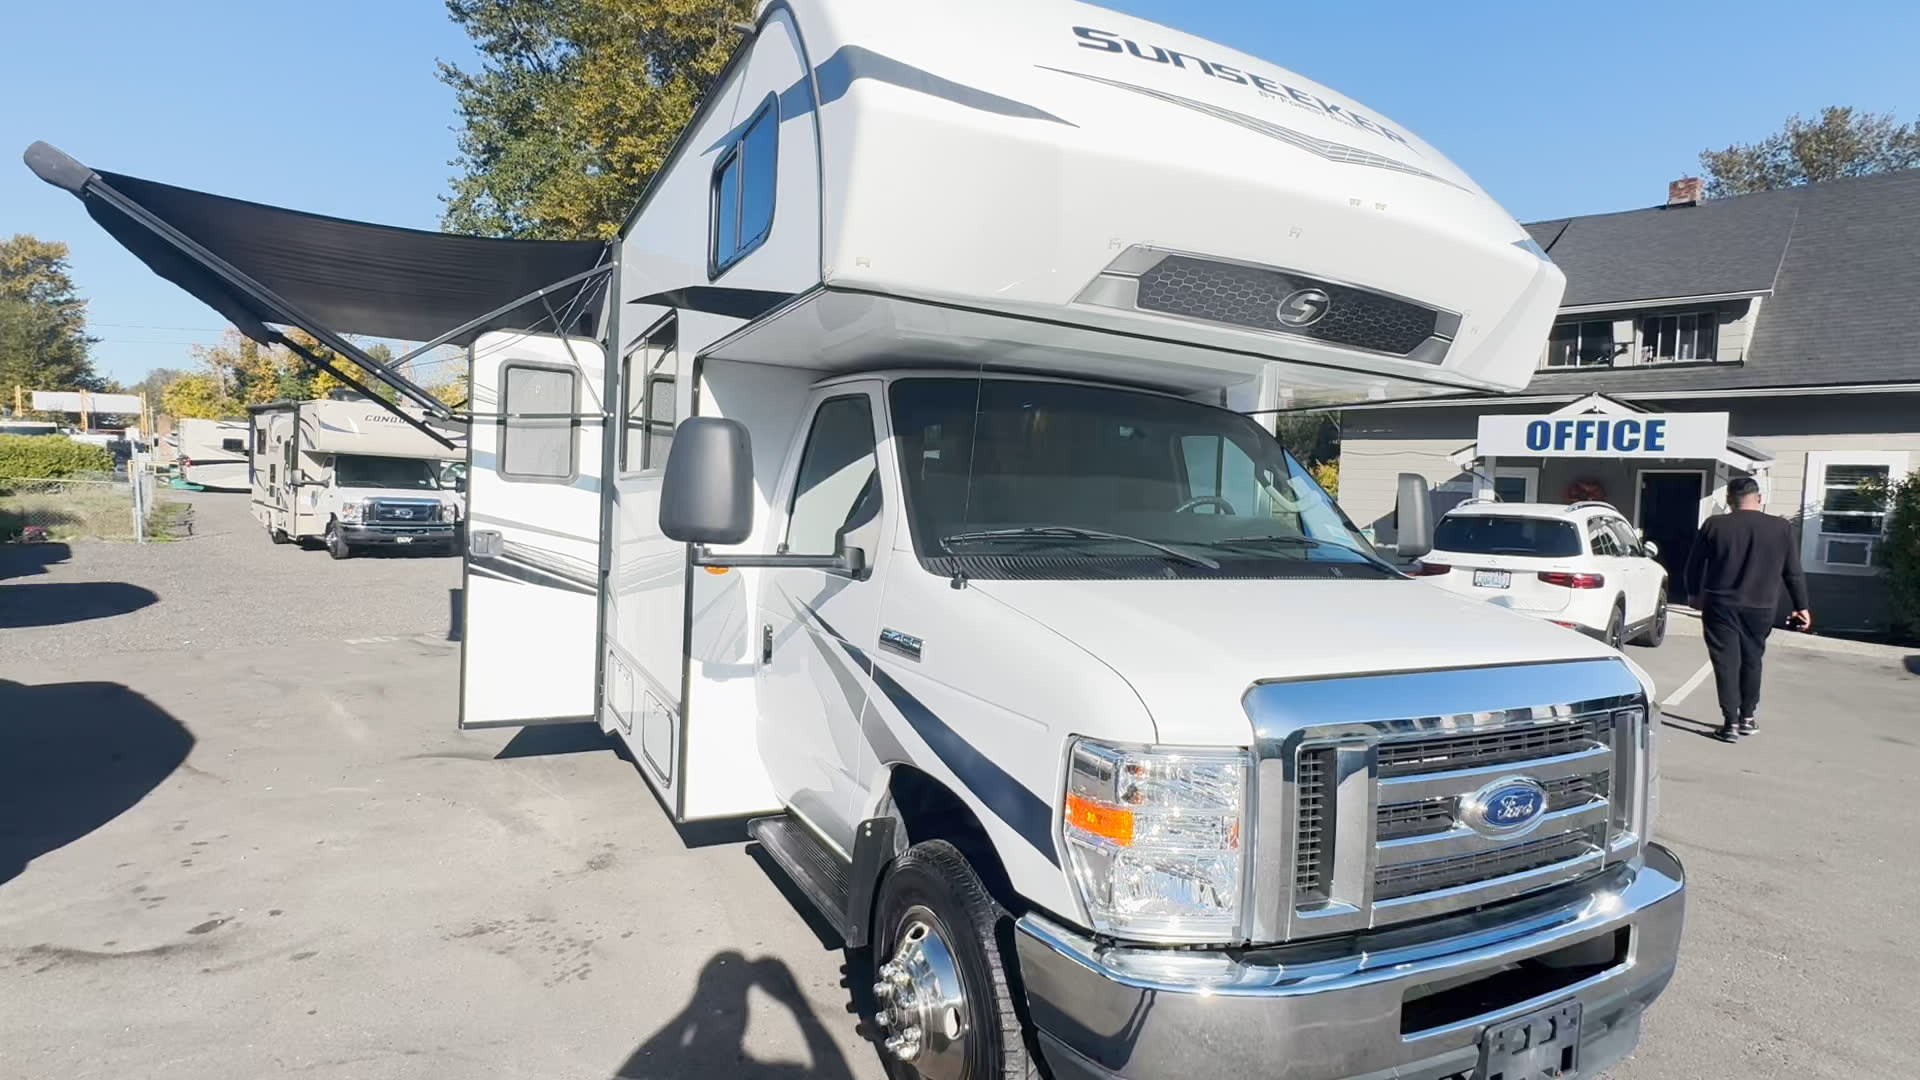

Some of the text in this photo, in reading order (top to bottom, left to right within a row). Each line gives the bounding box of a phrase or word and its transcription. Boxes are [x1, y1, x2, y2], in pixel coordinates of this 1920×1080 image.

[1073, 26, 1422, 157] SUNSEEKER
[1526, 419, 1666, 451] OFFICE
[1496, 793, 1535, 819] Ford
